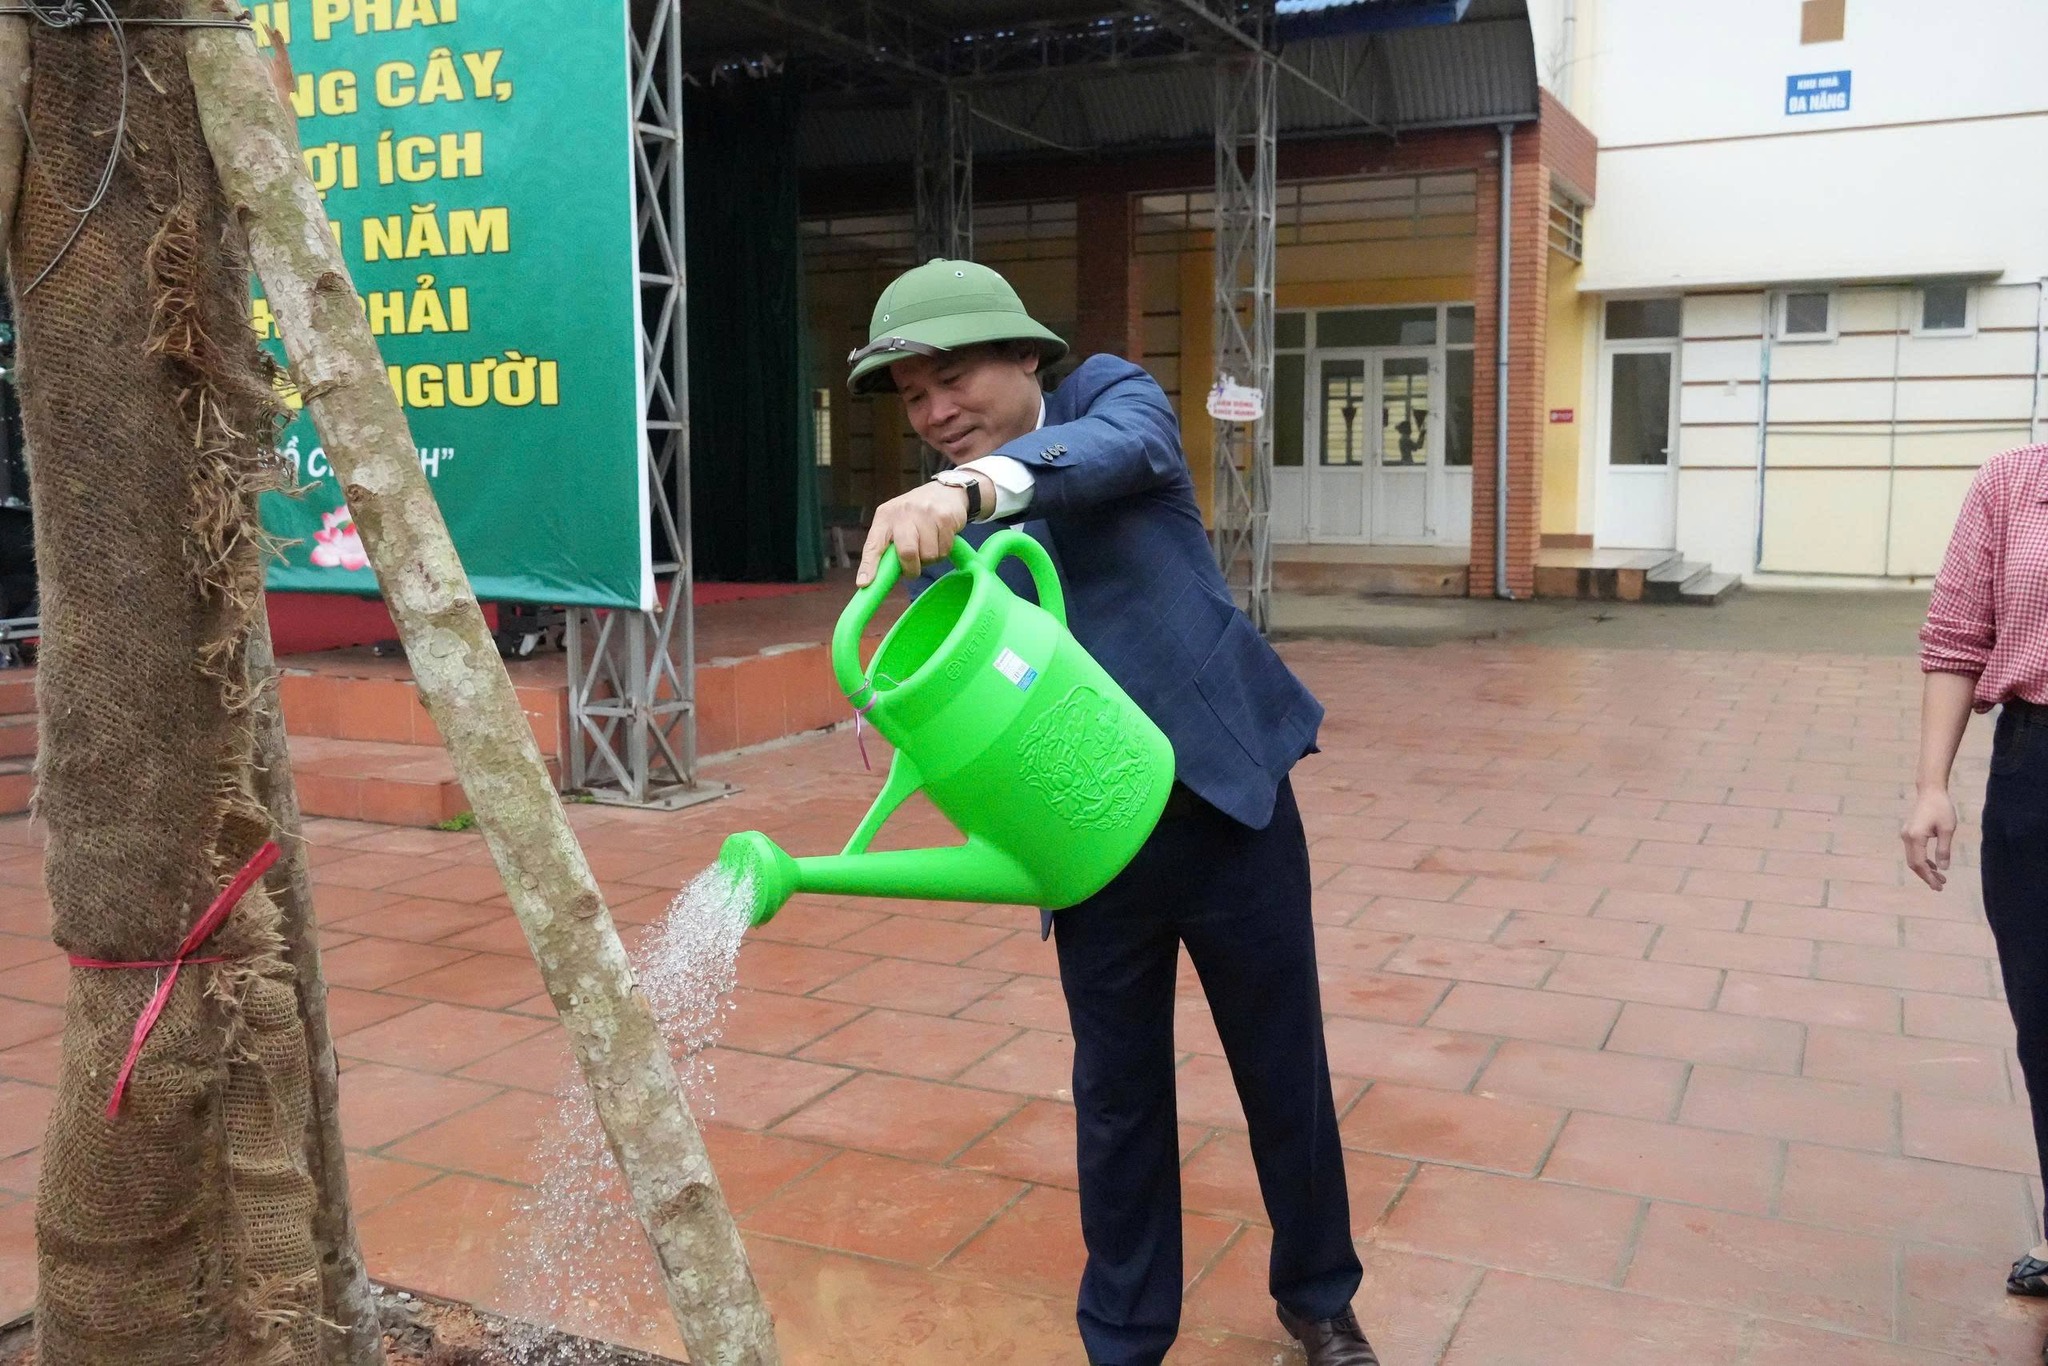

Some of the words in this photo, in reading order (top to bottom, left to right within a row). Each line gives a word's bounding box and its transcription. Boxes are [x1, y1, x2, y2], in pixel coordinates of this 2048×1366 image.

[375, 47, 513, 107] CÂY,
[377, 130, 483, 185] ÍCH
[362, 202, 509, 262] NĂM
[358, 274, 470, 335] HẢI
